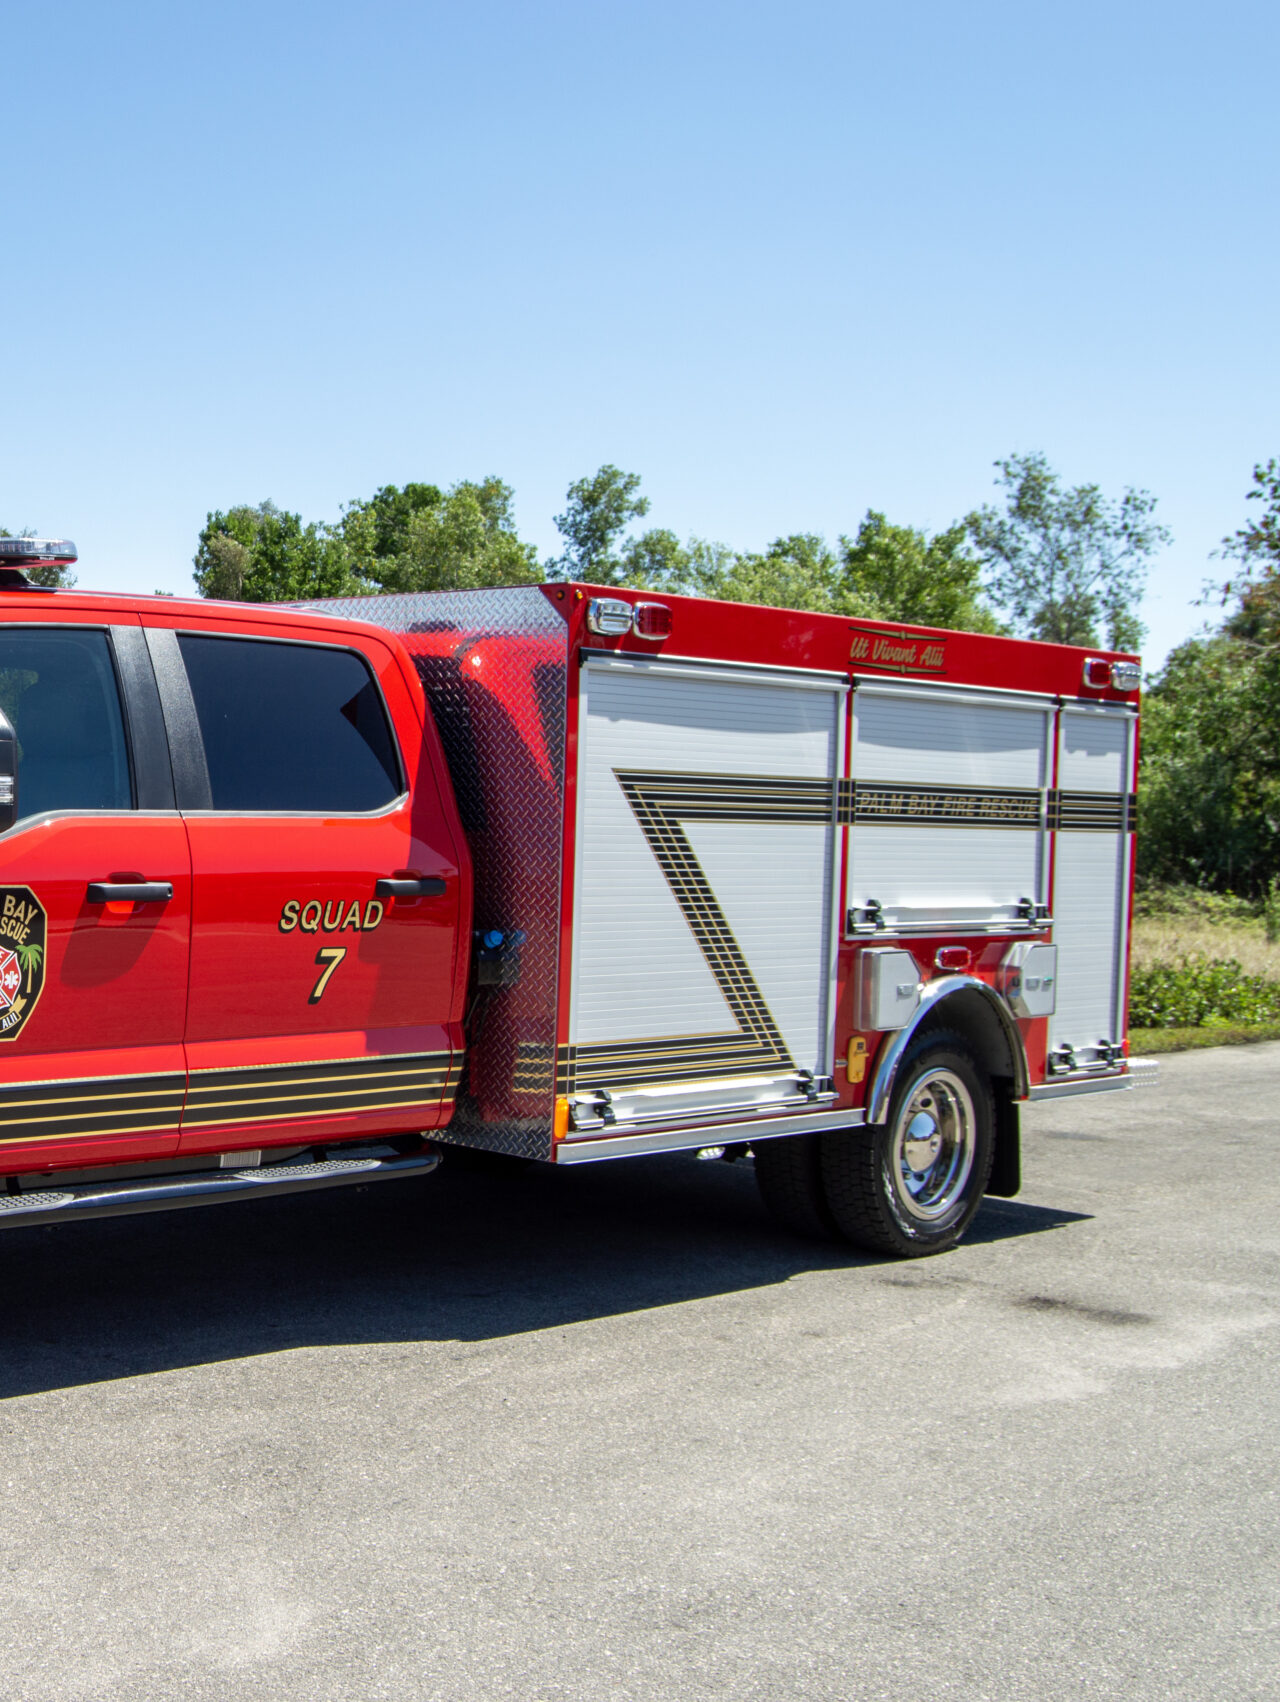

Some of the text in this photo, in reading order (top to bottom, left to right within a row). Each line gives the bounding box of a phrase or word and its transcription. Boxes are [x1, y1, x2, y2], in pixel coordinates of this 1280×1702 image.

[872, 638, 917, 664] Vivant
[919, 645, 945, 667] Alii
[858, 792, 1038, 819] PALM BAY FIRE RESCUE
[3, 894, 38, 926] BAY
[278, 900, 384, 934] SQUAD
[307, 946, 347, 1005] 7
[2, 1012, 18, 1030] ALII
